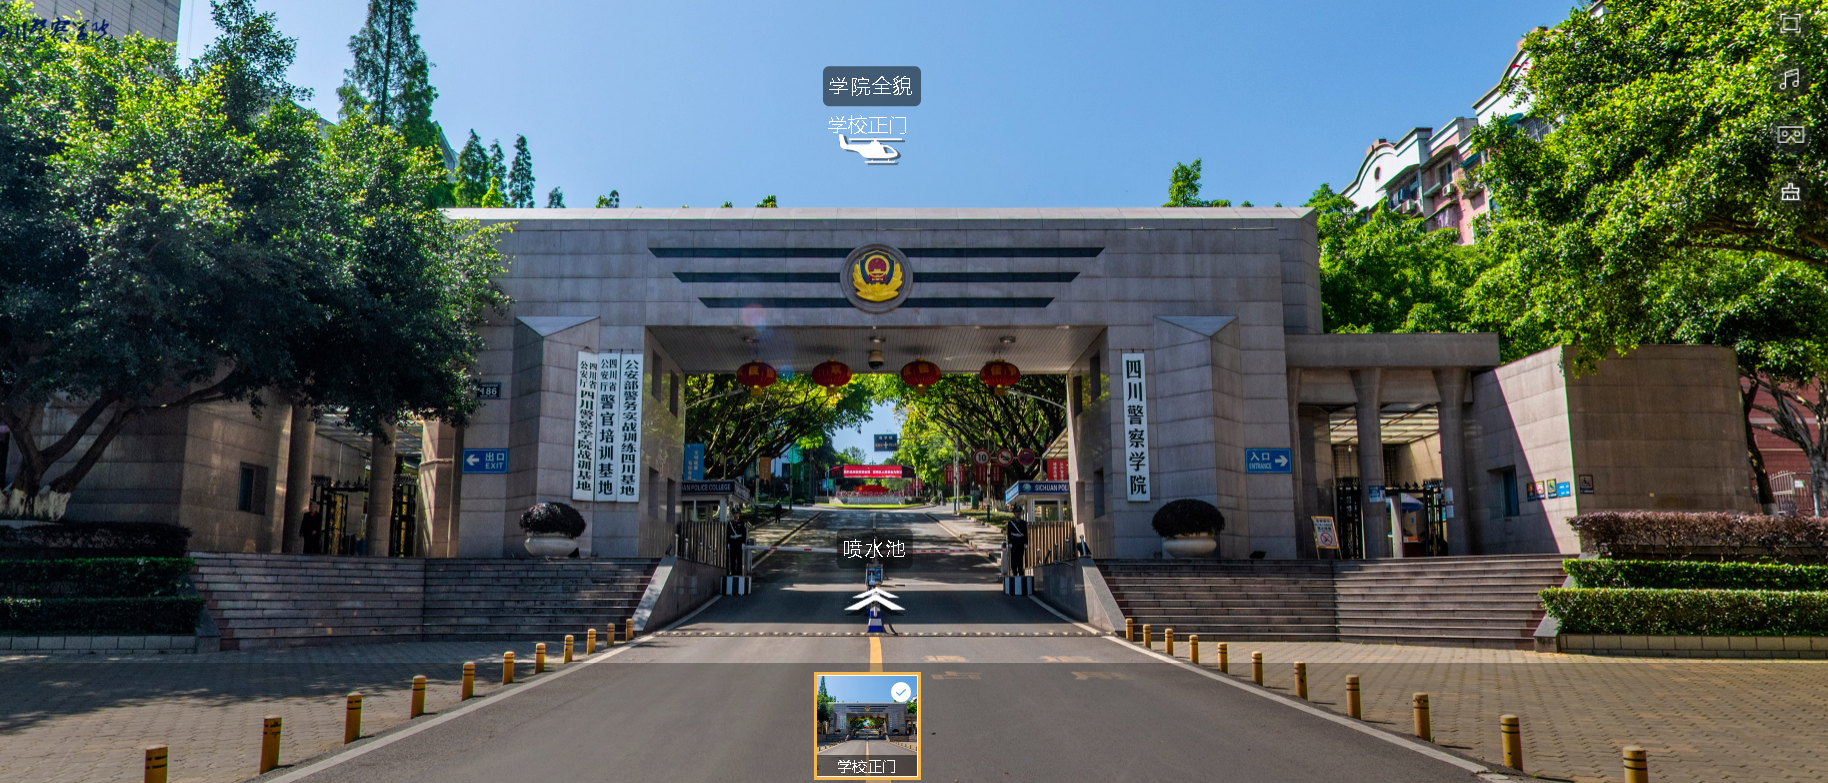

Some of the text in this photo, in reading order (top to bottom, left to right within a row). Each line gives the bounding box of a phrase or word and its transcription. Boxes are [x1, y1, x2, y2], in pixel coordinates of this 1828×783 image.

[600, 359, 609, 391] 公安厅
[609, 359, 618, 391] 四川省
[620, 359, 639, 496] 公安部警务实战训练四川基地
[1126, 359, 1147, 495] 四川警察学院
[598, 394, 615, 495] 警官培训基地
[485, 452, 505, 462] 出口
[978, 453, 987, 463] 10
[1250, 451, 1270, 461] 入口
[1249, 462, 1272, 470] ENTRANCE
[691, 484, 708, 492] POLICE
[708, 483, 731, 492] COLLEGE
[1034, 484, 1058, 492] SICHUAN
